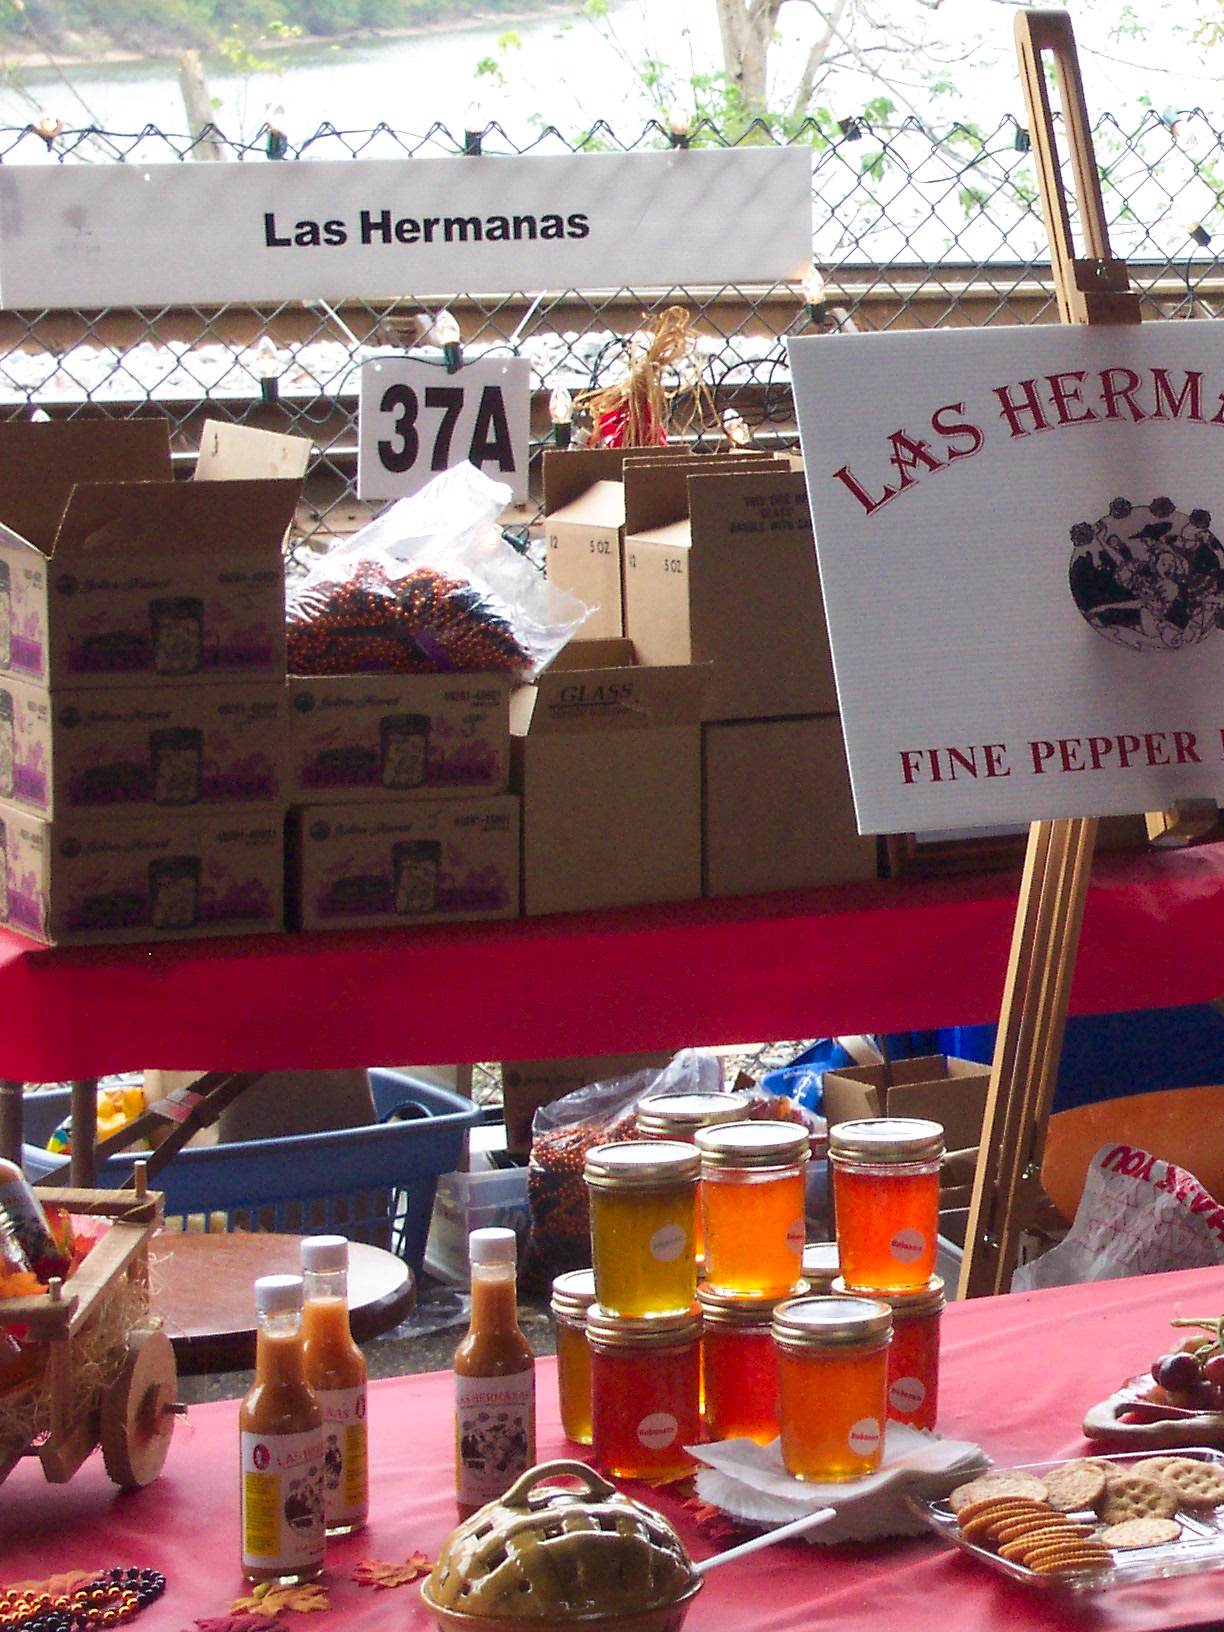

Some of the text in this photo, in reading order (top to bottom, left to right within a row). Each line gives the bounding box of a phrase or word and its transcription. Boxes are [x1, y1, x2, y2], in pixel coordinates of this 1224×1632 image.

[264, 209, 590, 247] Las Hermanas
[377, 383, 516, 473] 37A
[833, 401, 985, 517] LAS
[560, 682, 633, 702] GLASS
[898, 742, 1012, 784] FINE
[1027, 729, 1201, 775] PEPPER
